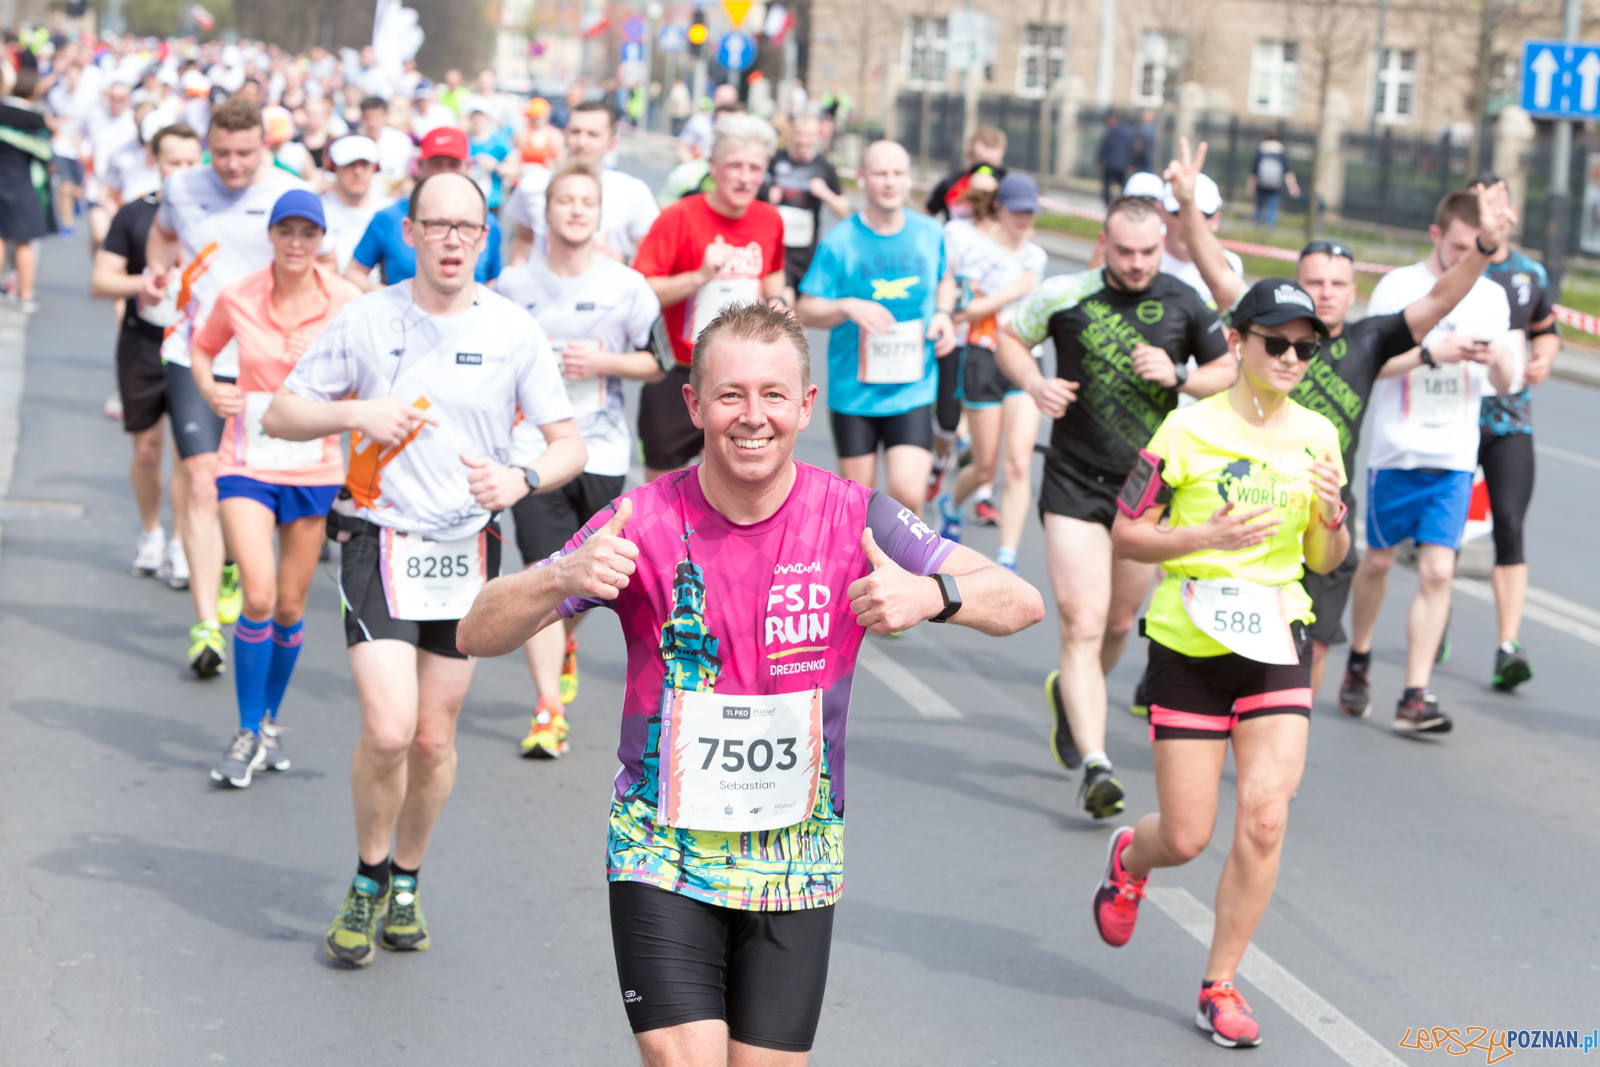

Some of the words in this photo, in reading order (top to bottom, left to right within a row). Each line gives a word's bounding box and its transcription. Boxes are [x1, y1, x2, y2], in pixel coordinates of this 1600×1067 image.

[407, 555, 469, 578] 8285
[767, 583, 831, 613] FSD
[765, 612, 830, 647] RUN
[1213, 610, 1262, 635] 588
[770, 658, 826, 676] DREZDENKO
[734, 709, 749, 717] PKO
[698, 736, 798, 773] 7503
[719, 779, 776, 791] Sebastian
